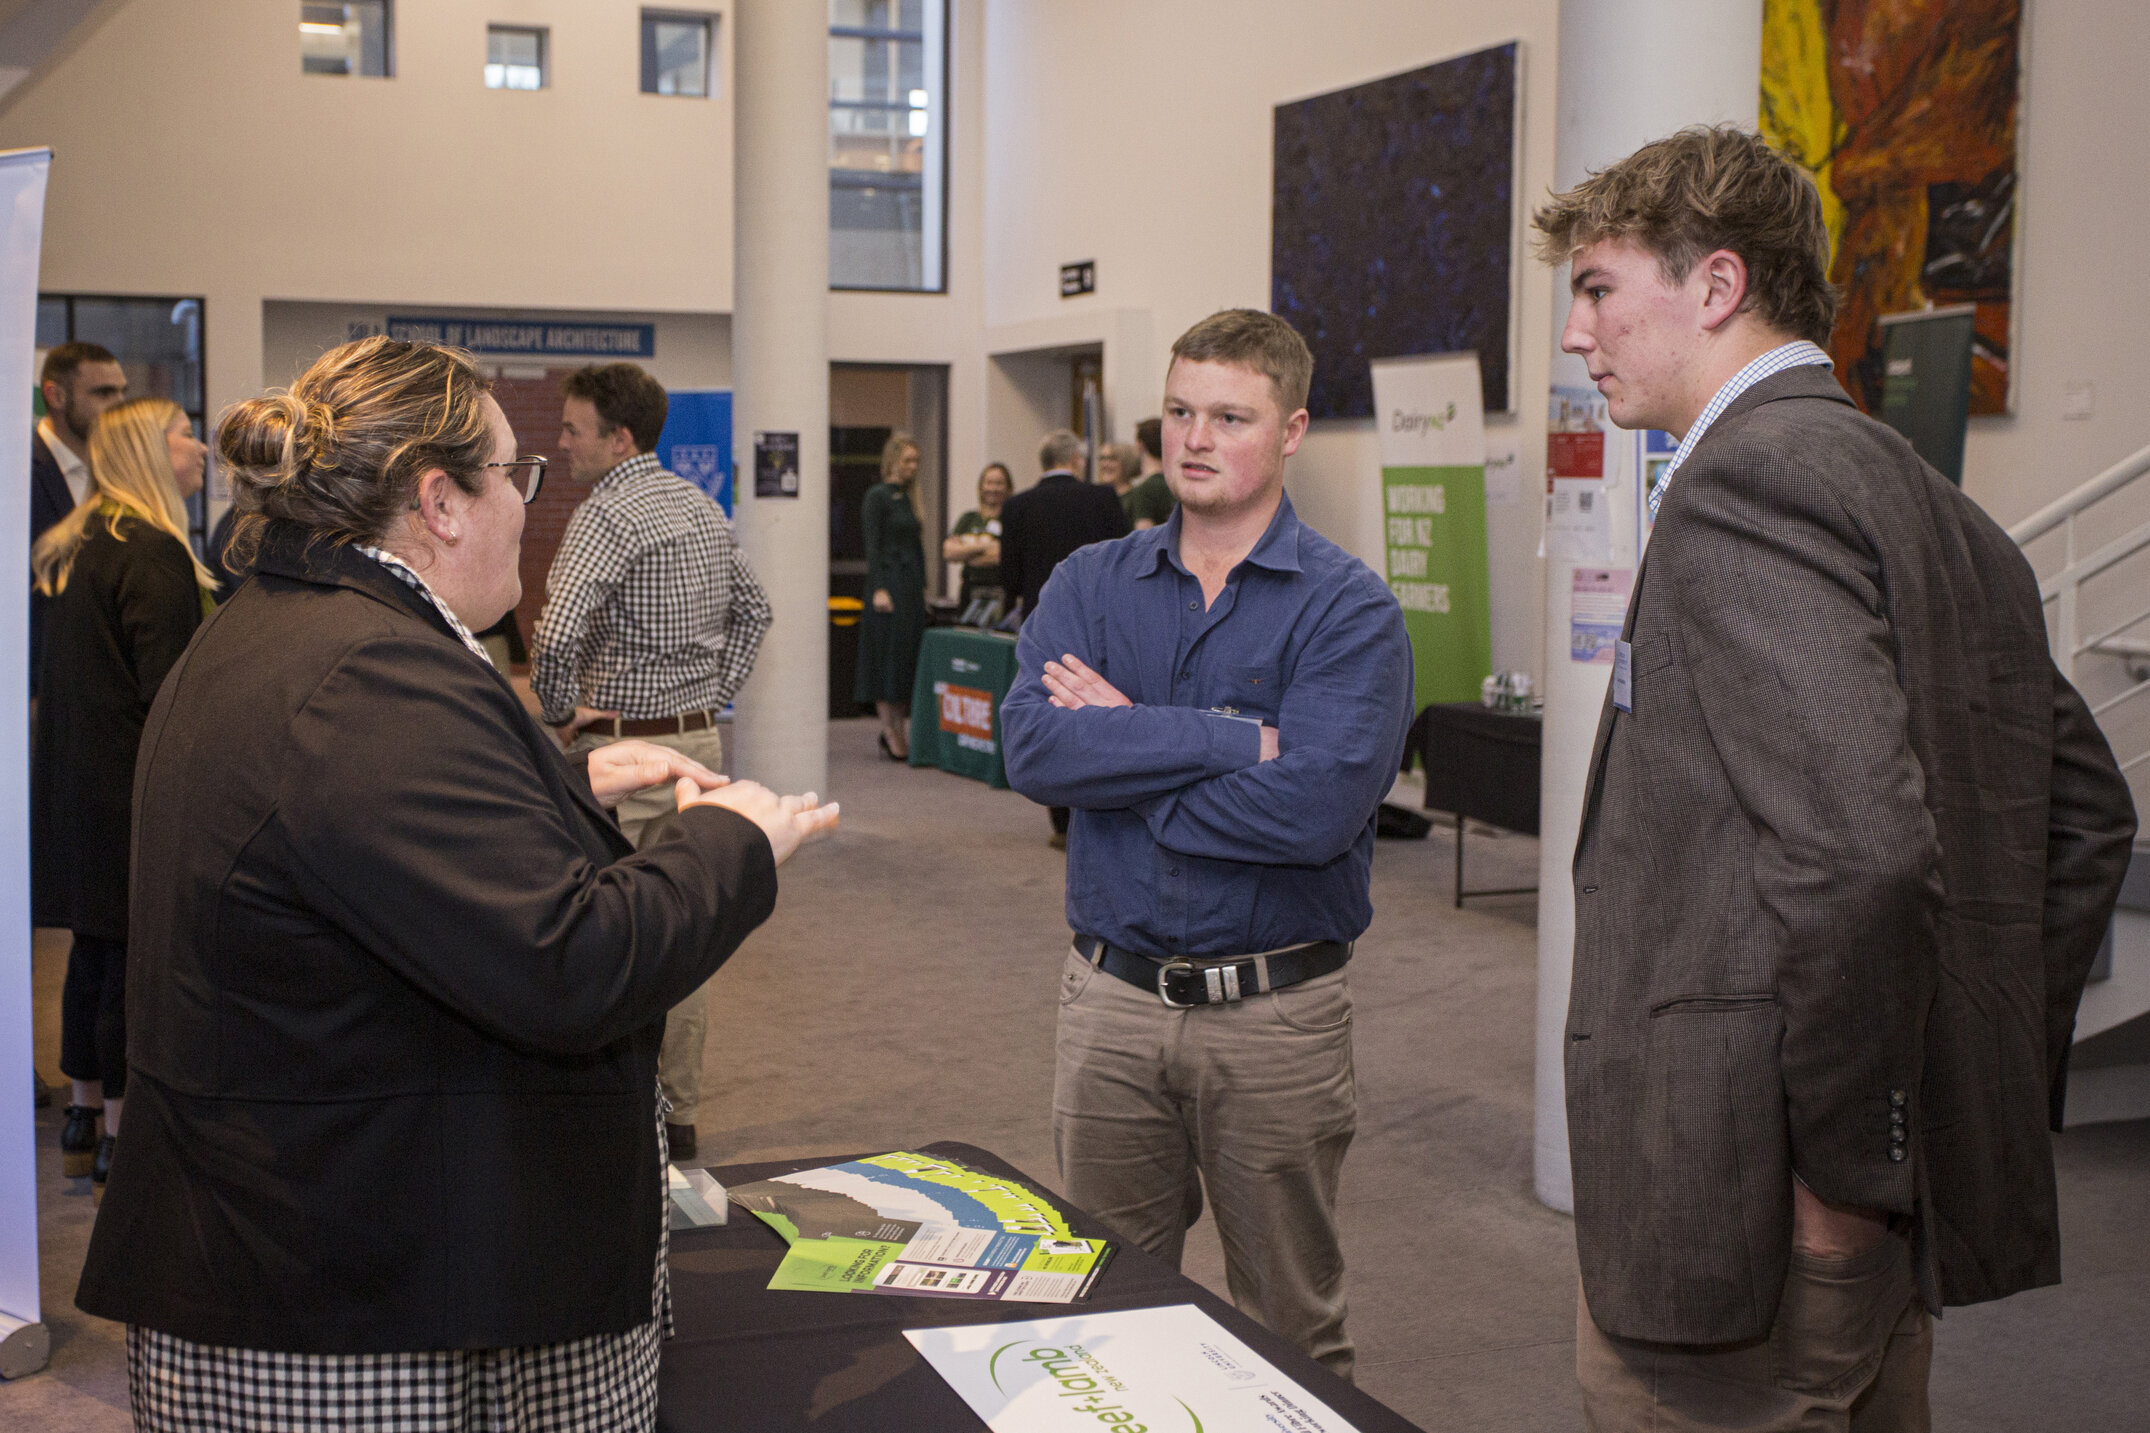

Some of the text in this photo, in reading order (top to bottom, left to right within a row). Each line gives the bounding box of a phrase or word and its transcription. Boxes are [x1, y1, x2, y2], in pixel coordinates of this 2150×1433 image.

[466, 324, 542, 348] LANDSCAPE
[546, 327, 641, 351] ARCHITECTURE
[840, 1258, 866, 1282] LOOKING
[853, 1244, 891, 1283] INFORMATION?
[1063, 1345, 1128, 1391] new zealand
[1021, 1348, 1148, 1433] eef+lamb
